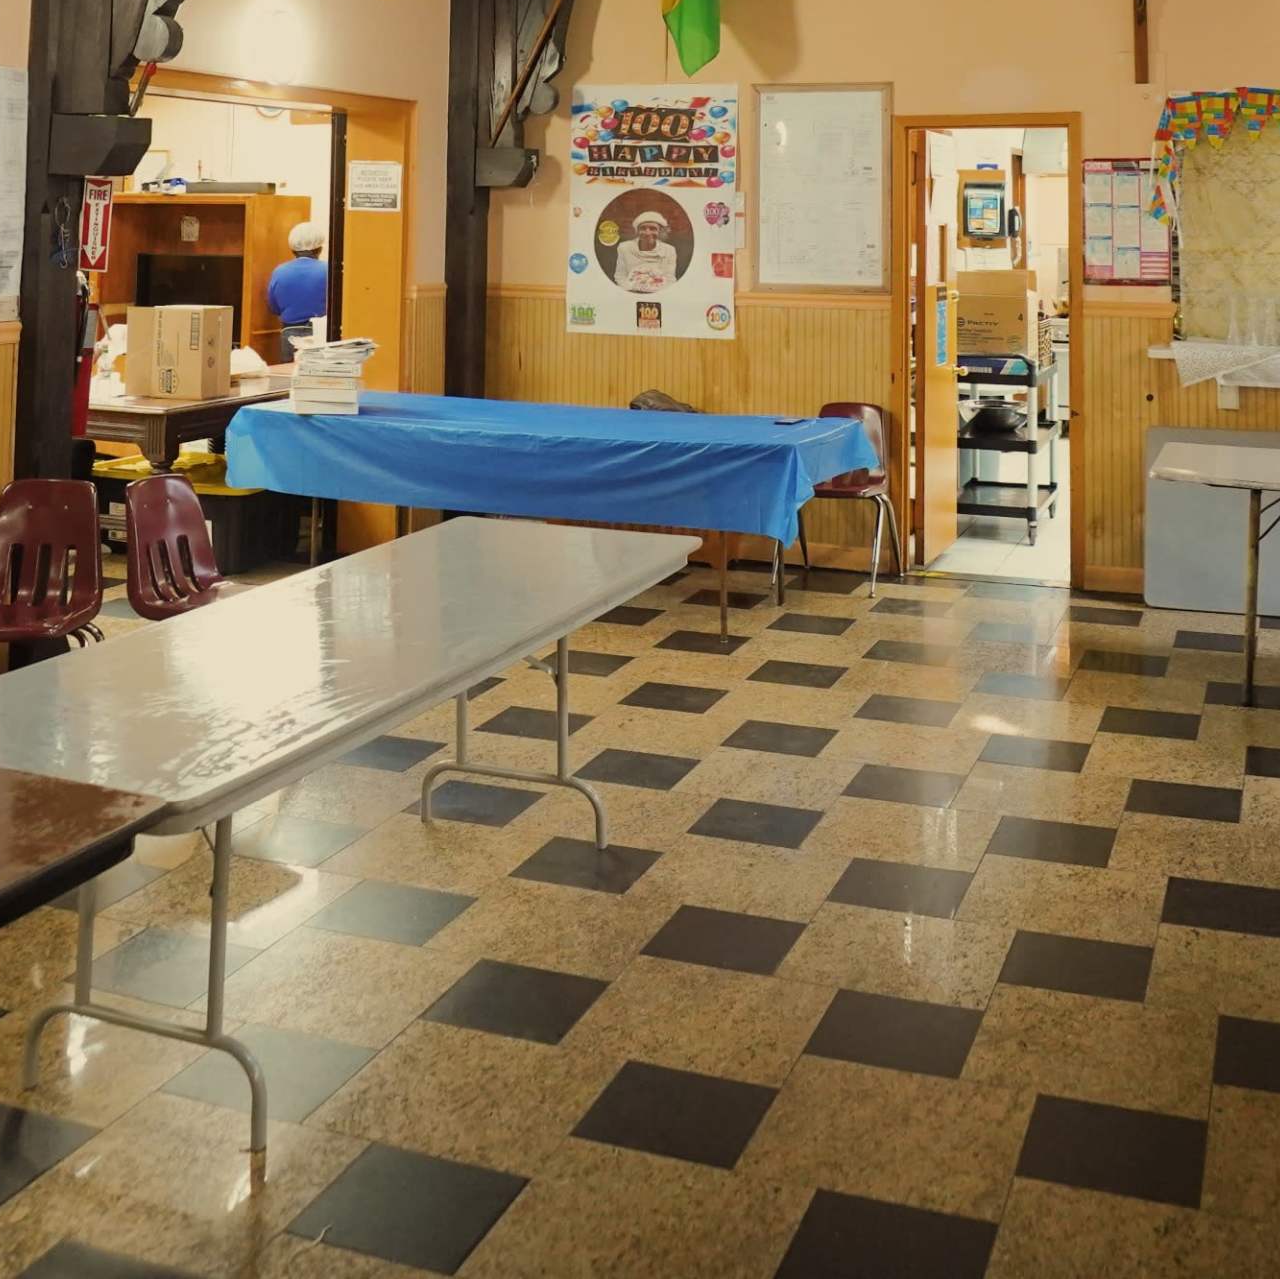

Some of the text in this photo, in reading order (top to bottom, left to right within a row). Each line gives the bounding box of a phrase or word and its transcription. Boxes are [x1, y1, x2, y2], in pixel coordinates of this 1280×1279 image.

[620, 111, 690, 137] 100
[590, 145, 717, 162] HAPPY
[88, 189, 108, 201] FIRE
[639, 307, 658, 319] 100
[710, 311, 730, 322] 100
